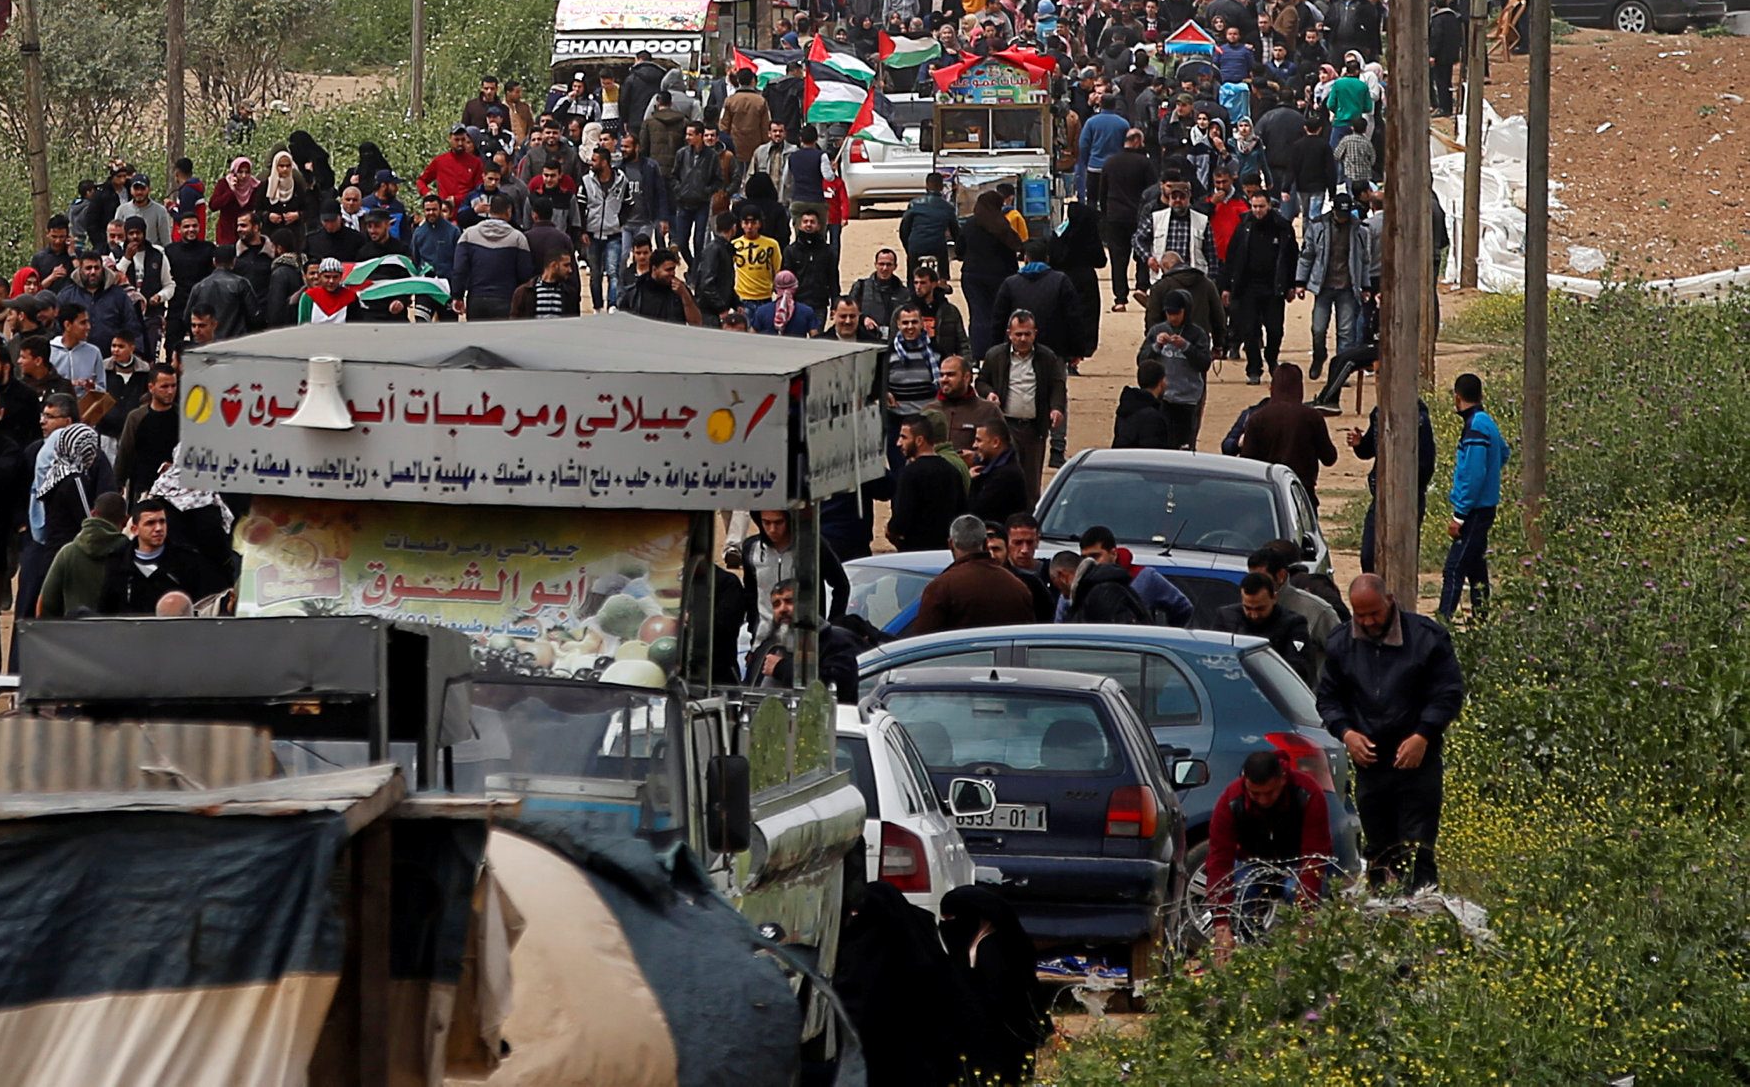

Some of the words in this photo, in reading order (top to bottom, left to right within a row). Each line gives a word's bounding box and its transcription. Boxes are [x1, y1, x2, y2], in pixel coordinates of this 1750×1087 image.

[402, 388, 568, 439] ومرطبات
[573, 392, 699, 450] جيلاتي
[383, 533, 493, 557] ومرطبات
[496, 537, 581, 562] جيلاتي
[523, 566, 588, 621] أبو
